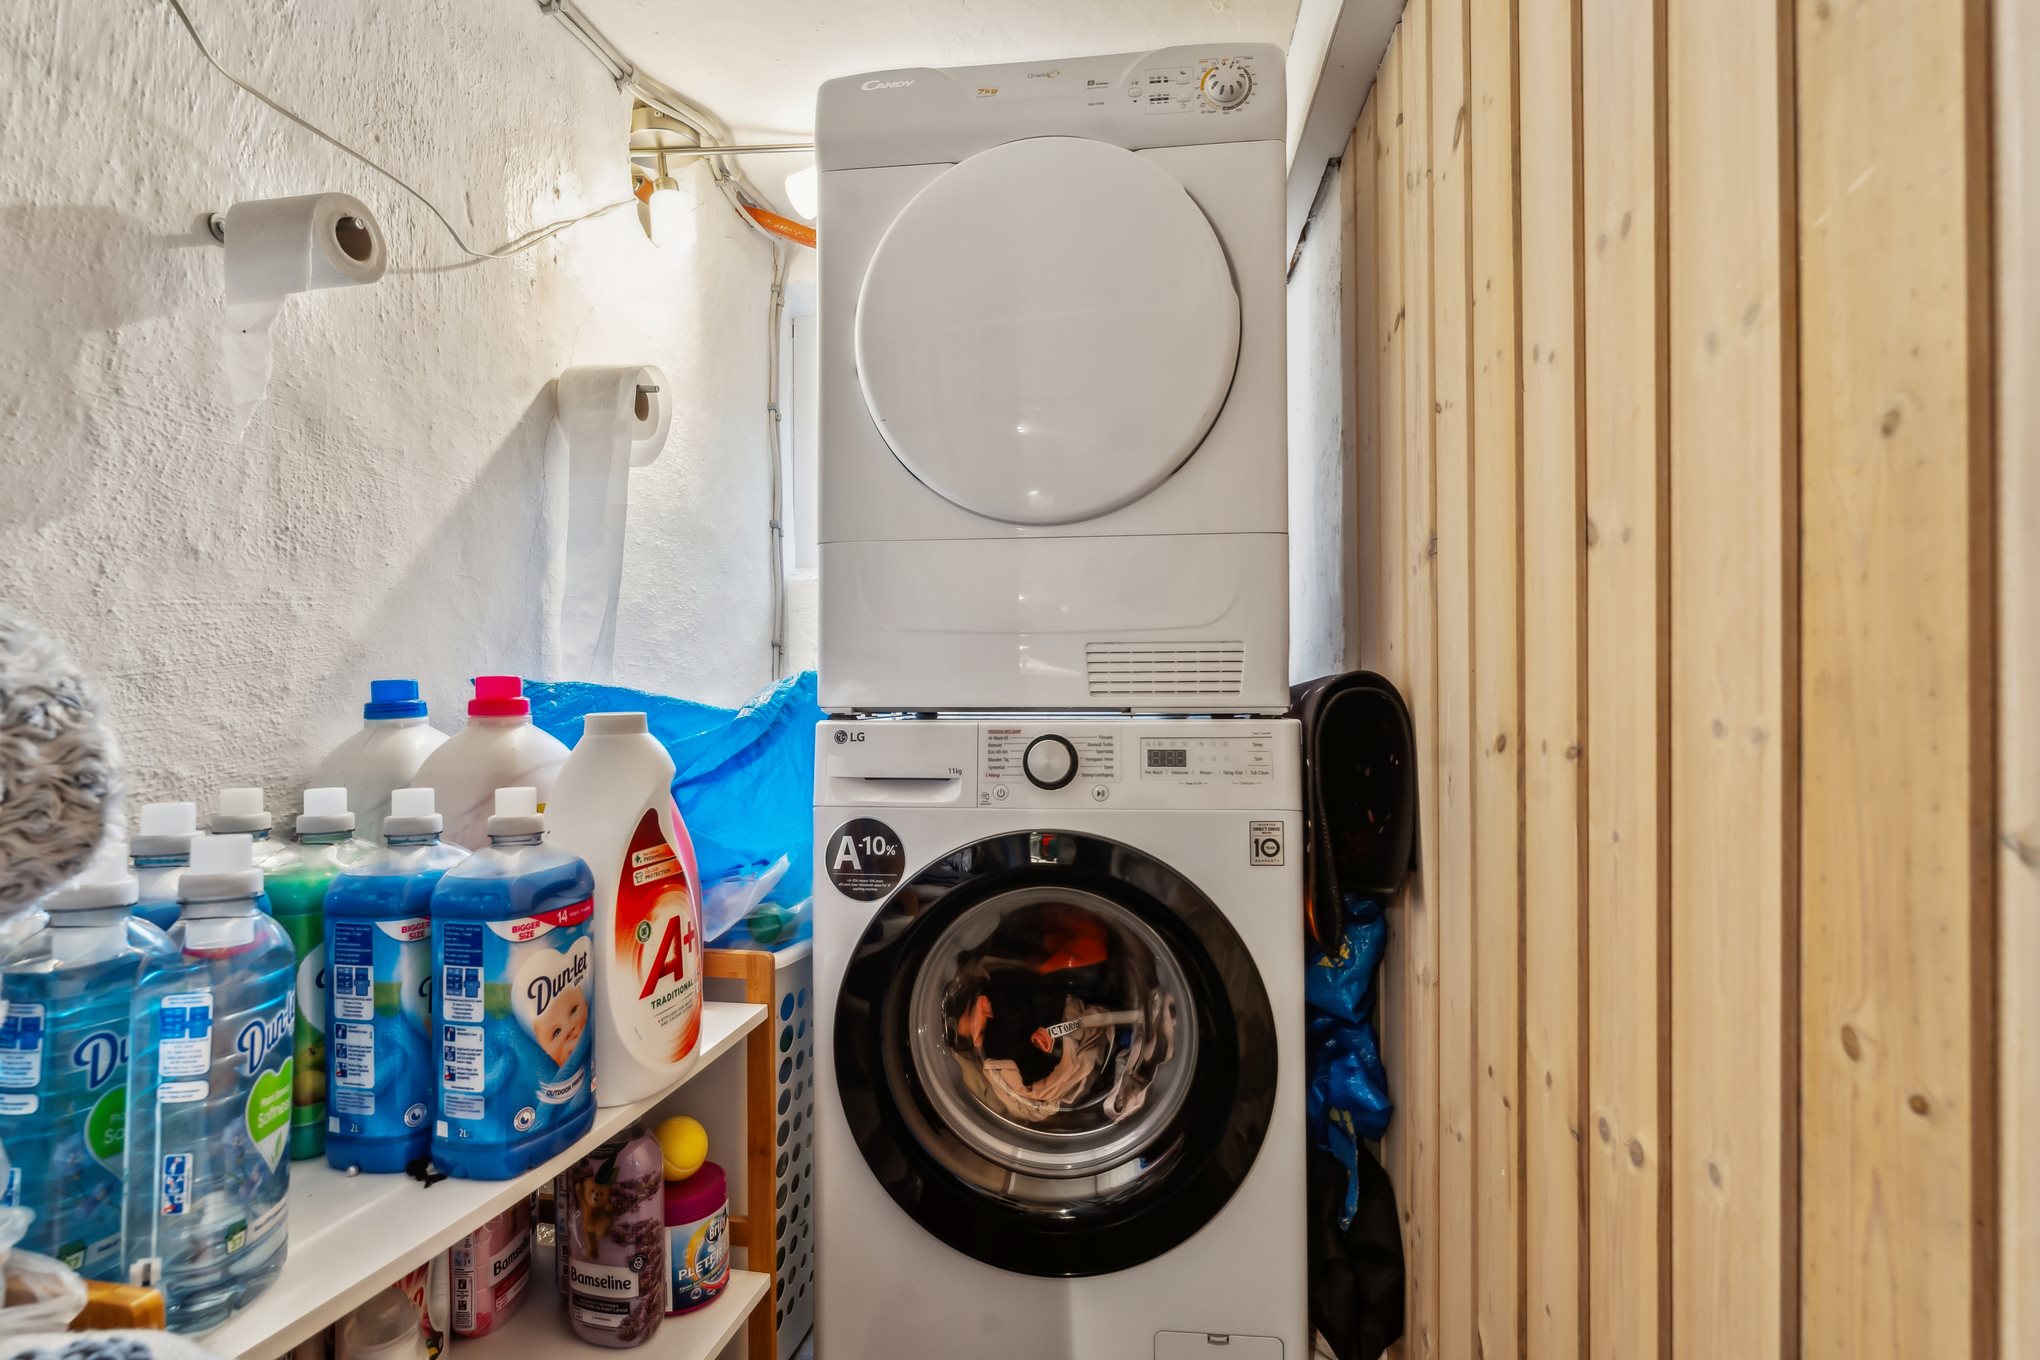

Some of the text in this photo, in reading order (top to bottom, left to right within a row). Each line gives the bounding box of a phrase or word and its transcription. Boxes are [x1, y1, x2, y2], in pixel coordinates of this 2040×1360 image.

[861, 79, 915, 91] CANDY
[977, 88, 998, 96] 7kg
[850, 732, 865, 742] LG
[948, 767, 963, 776] 11kg
[1254, 838, 1280, 857] 10
[644, 868, 671, 879] PROTECTION
[556, 910, 569, 924] 14
[511, 920, 541, 934] BIGGER
[408, 929, 425, 940] SIZE
[518, 930, 535, 940] SIZE
[651, 978, 694, 1010] TRADITIONAL
[546, 1084, 571, 1097] OUTDOOR
[458, 1128, 468, 1138] 2L
[570, 1265, 632, 1291] Bamseline
